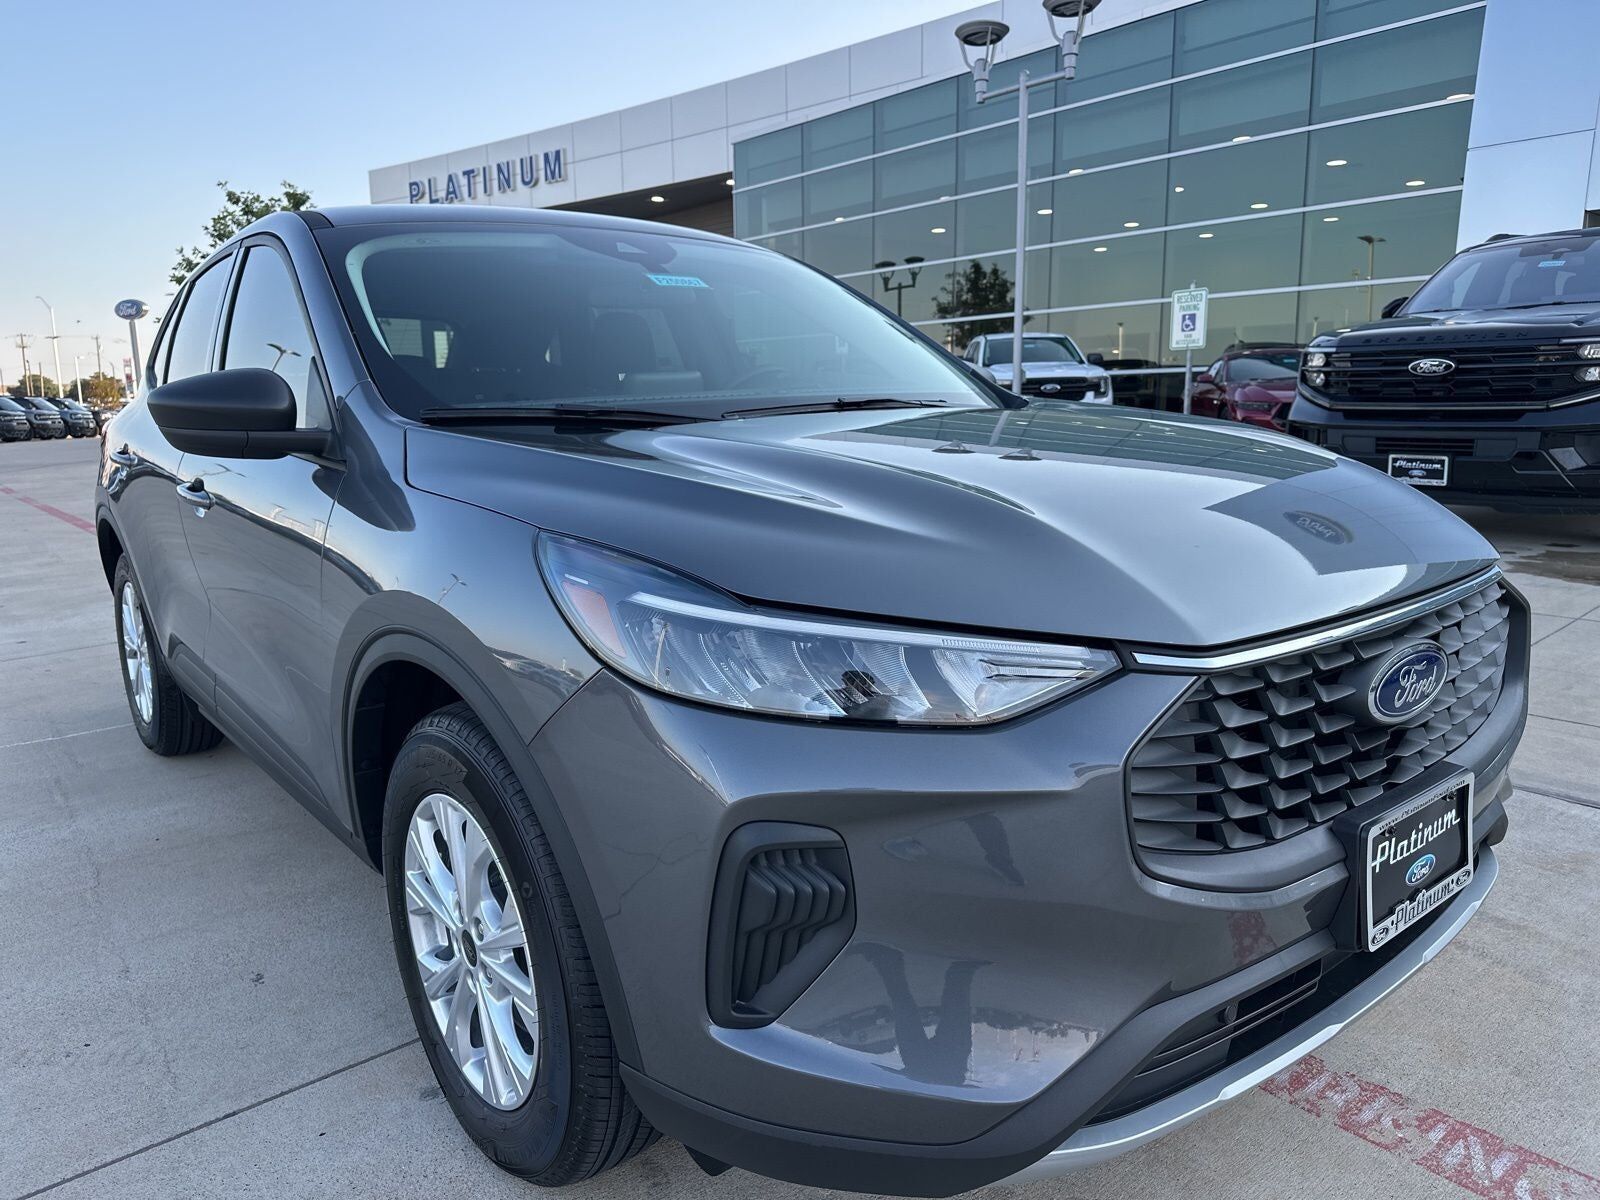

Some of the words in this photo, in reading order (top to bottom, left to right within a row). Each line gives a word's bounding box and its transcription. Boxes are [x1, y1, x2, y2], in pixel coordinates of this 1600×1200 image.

[409, 149, 564, 203] PLATINUM
[1177, 293, 1203, 303] RESERVED
[1179, 303, 1201, 312] PARKING
[1393, 460, 1443, 470] Platinum
[1394, 660, 1437, 708] Ford
[1371, 808, 1460, 873] Platinum
[1393, 880, 1455, 932] Platinum
